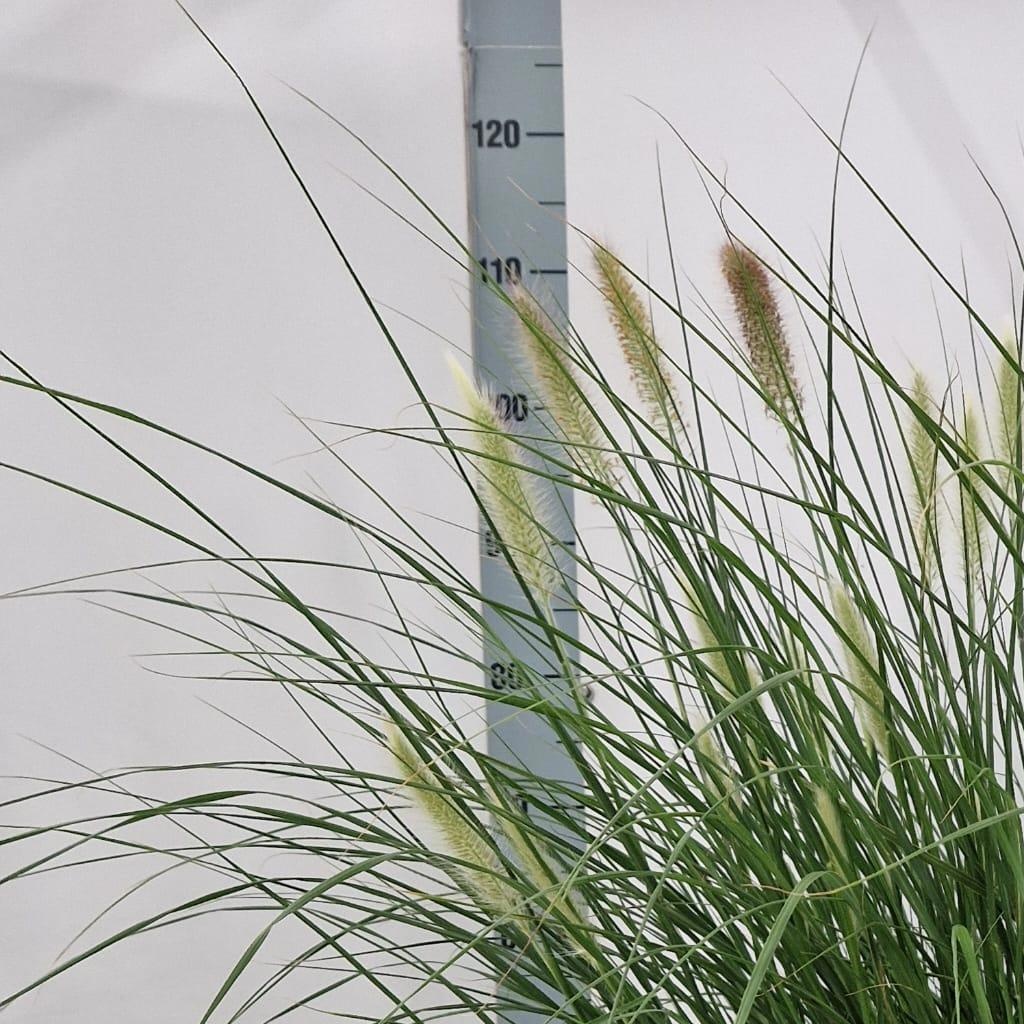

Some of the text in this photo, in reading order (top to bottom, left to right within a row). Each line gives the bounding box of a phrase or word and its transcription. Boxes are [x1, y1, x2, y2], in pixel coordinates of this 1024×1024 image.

[472, 119, 520, 149] 120
[479, 256, 522, 284] 110
[484, 393, 528, 421] 00
